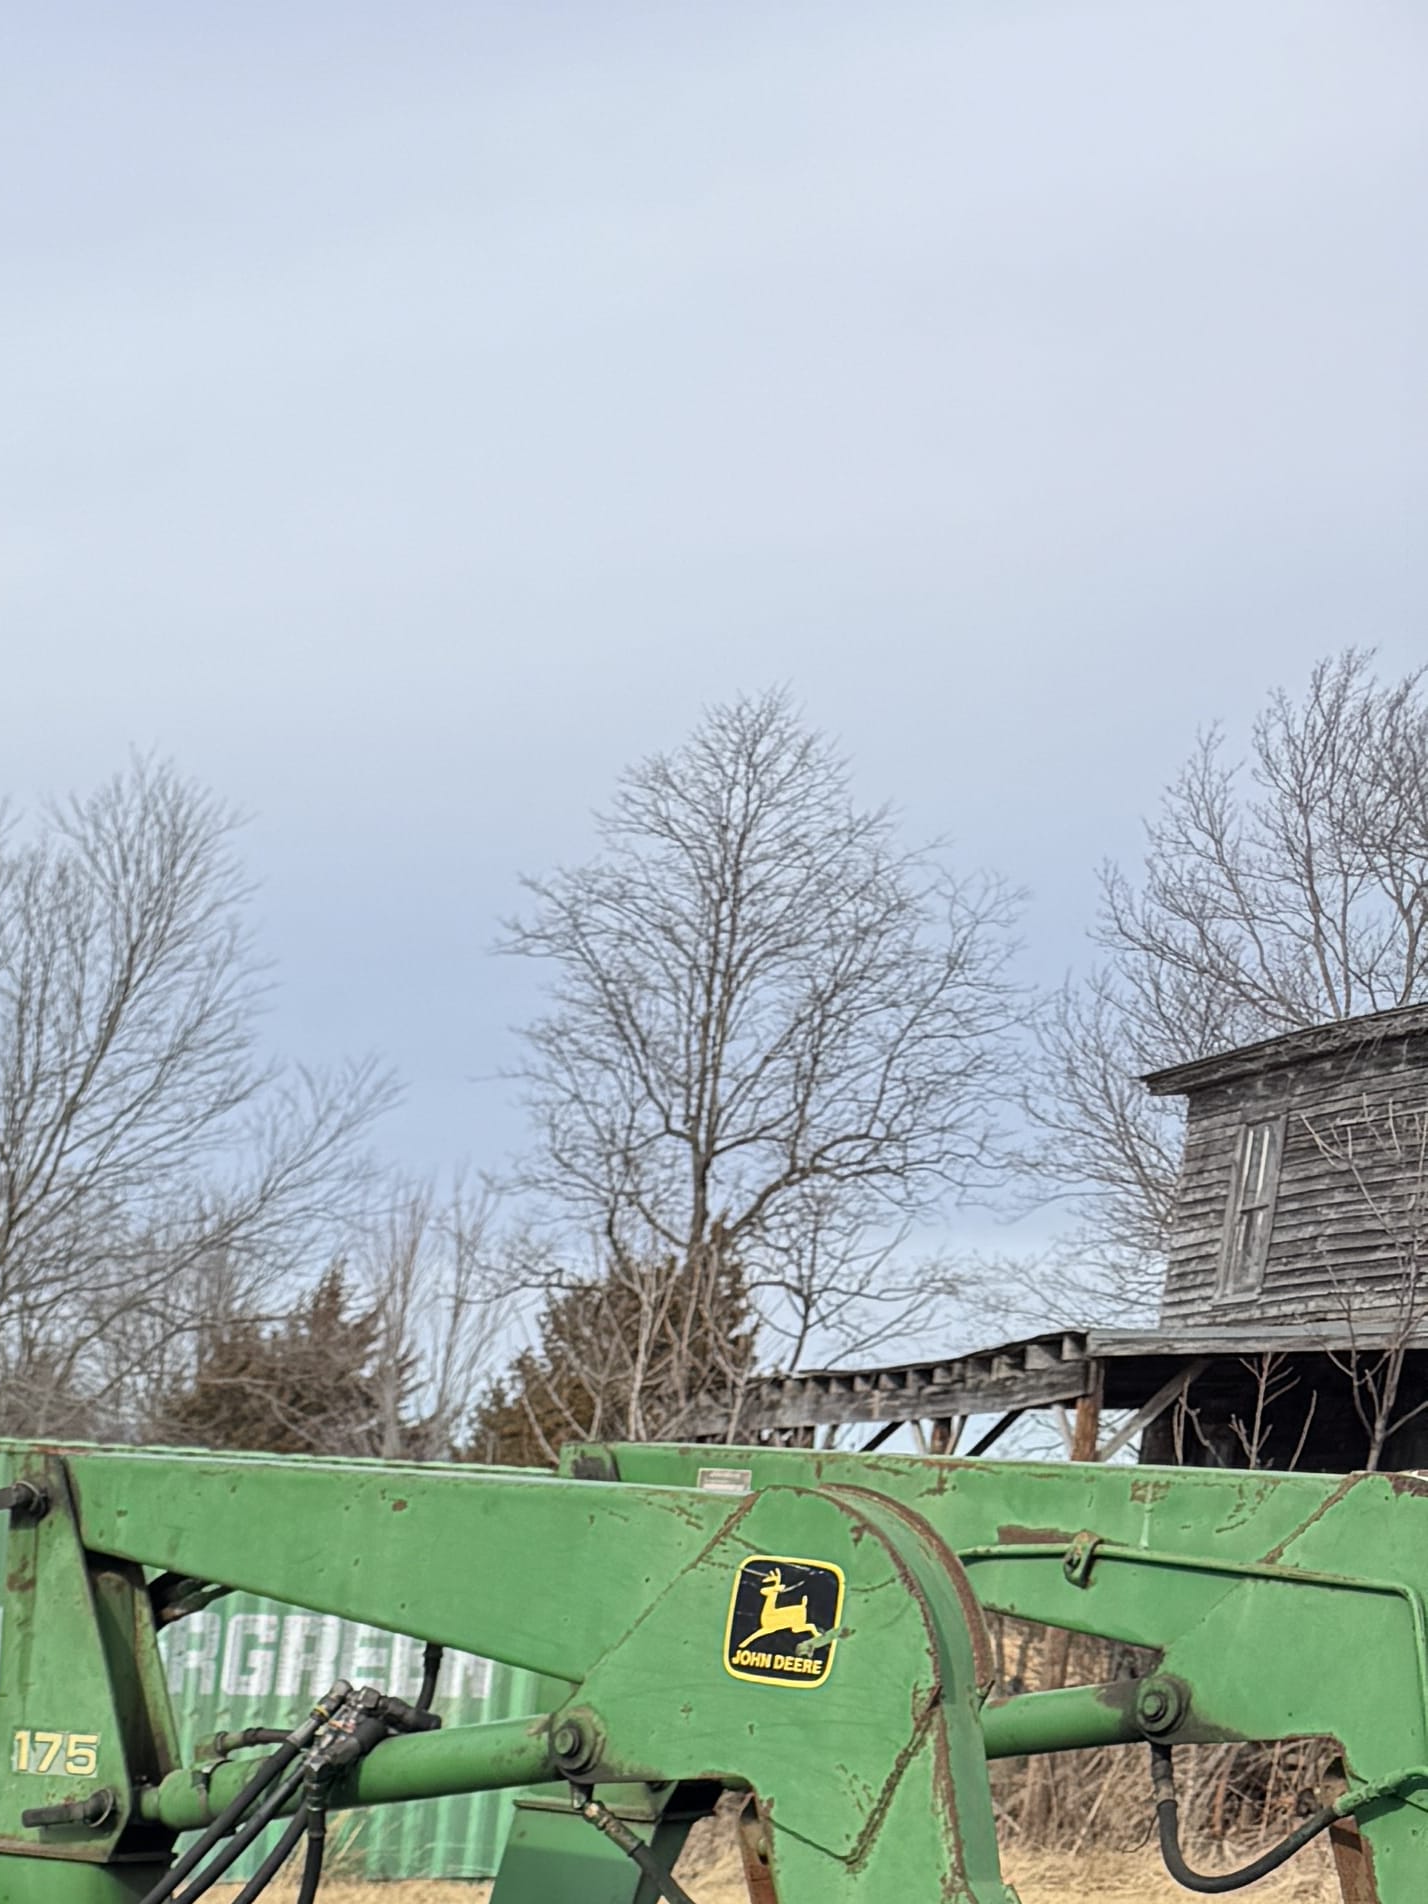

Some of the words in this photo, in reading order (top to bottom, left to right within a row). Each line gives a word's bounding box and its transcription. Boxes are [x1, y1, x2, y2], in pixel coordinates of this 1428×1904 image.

[731, 1649, 773, 1669] JOHN
[772, 1654, 824, 1675] DEERE
[14, 1730, 98, 1776] 175
